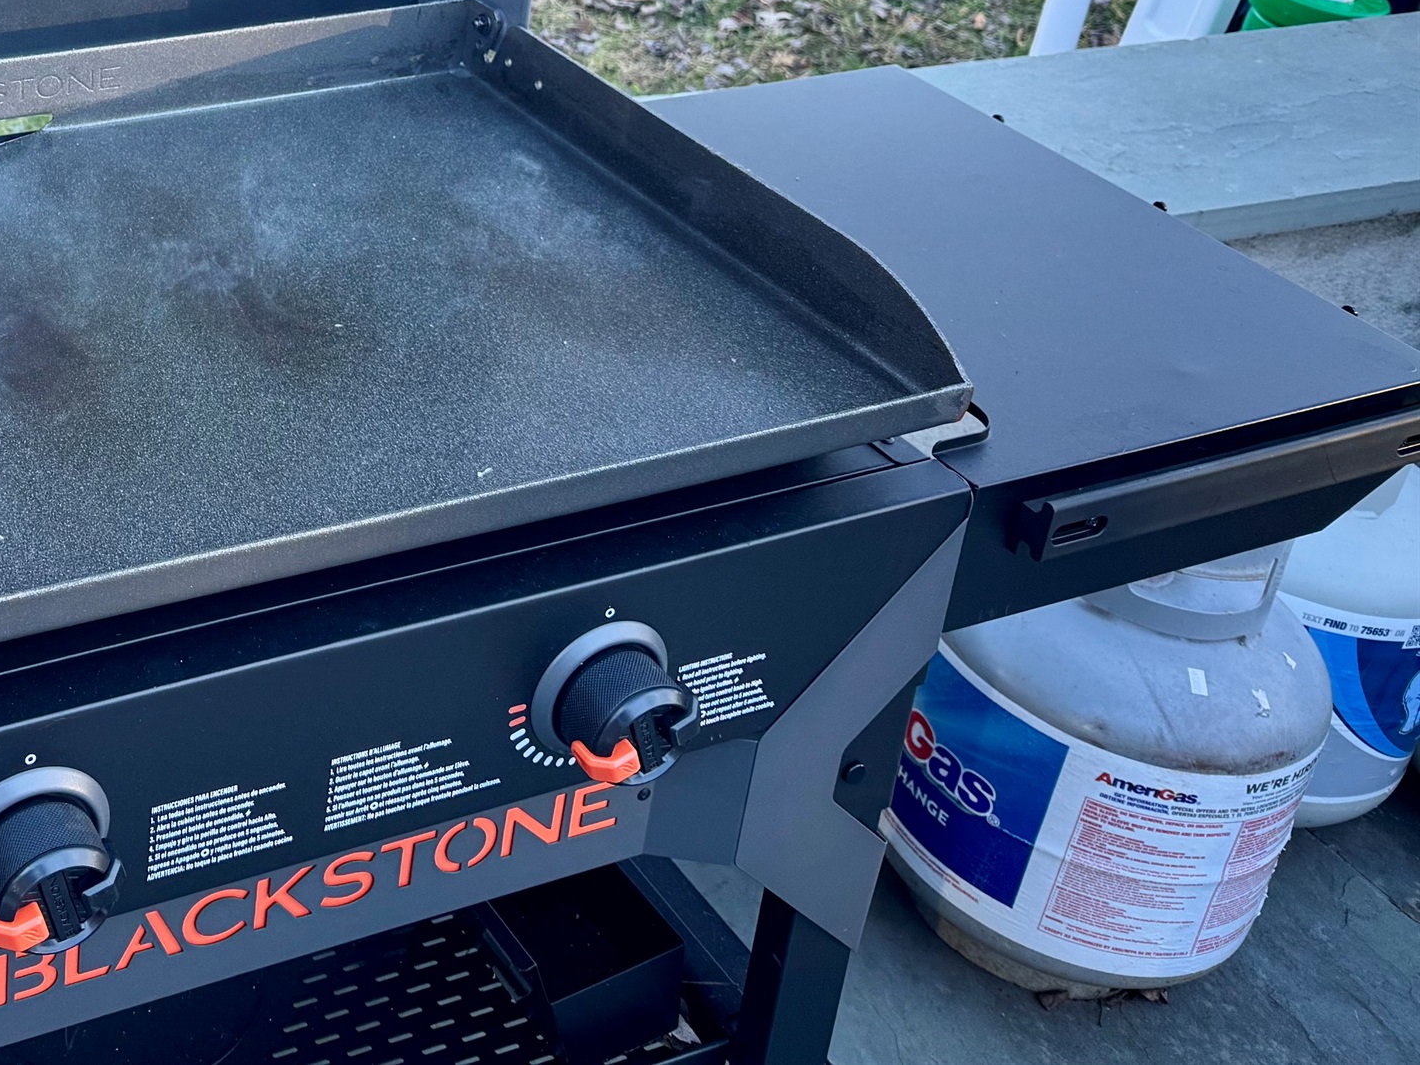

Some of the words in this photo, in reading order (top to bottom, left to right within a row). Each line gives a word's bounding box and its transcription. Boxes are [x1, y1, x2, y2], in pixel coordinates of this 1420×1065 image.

[1302, 612, 1323, 624] TEXT
[1323, 617, 1348, 631] FIND
[1349, 624, 1360, 633] TO
[331, 750, 368, 765] INSTRUCTIONS
[151, 796, 194, 814] INSTRUCCIONES
[194, 792, 209, 802] PARA
[209, 784, 238, 798] ENCENDER
[897, 765, 950, 827] HANGE
[1095, 771, 1199, 805] AmeriGas
[1246, 774, 1291, 795] WE'RE
[149, 826, 155, 834] 2.
[156, 823, 170, 832] Abra
[170, 820, 177, 828] la
[177, 814, 201, 826] cubierta
[202, 809, 218, 819] antes
[218, 807, 226, 815] de
[226, 800, 254, 812] encender.
[157, 814, 168, 822] Lea
[168, 809, 184, 819] todas
[194, 796, 233, 811] instrucciones
[233, 791, 250, 801] antes
[250, 789, 258, 797] de
[258, 782, 286, 794] encender.
[155, 829, 181, 841] Presione
[181, 826, 188, 834] el
[205, 820, 213, 828] de
[213, 812, 244, 825] encendido.
[155, 840, 176, 851] Empuje
[176, 838, 181, 846] y
[181, 835, 193, 845] gire
[200, 828, 218, 839] perilla
[219, 825, 226, 833] de
[226, 819, 248, 831] control
[248, 815, 263, 825] hacia
[263, 812, 276, 821] Alto.
[154, 852, 160, 860] Si
[160, 850, 167, 859] el
[167, 843, 197, 857] encendido
[213, 832, 236, 845] produce
[236, 830, 245, 838] en
[49, 874, 77, 936] BLACKSTON
